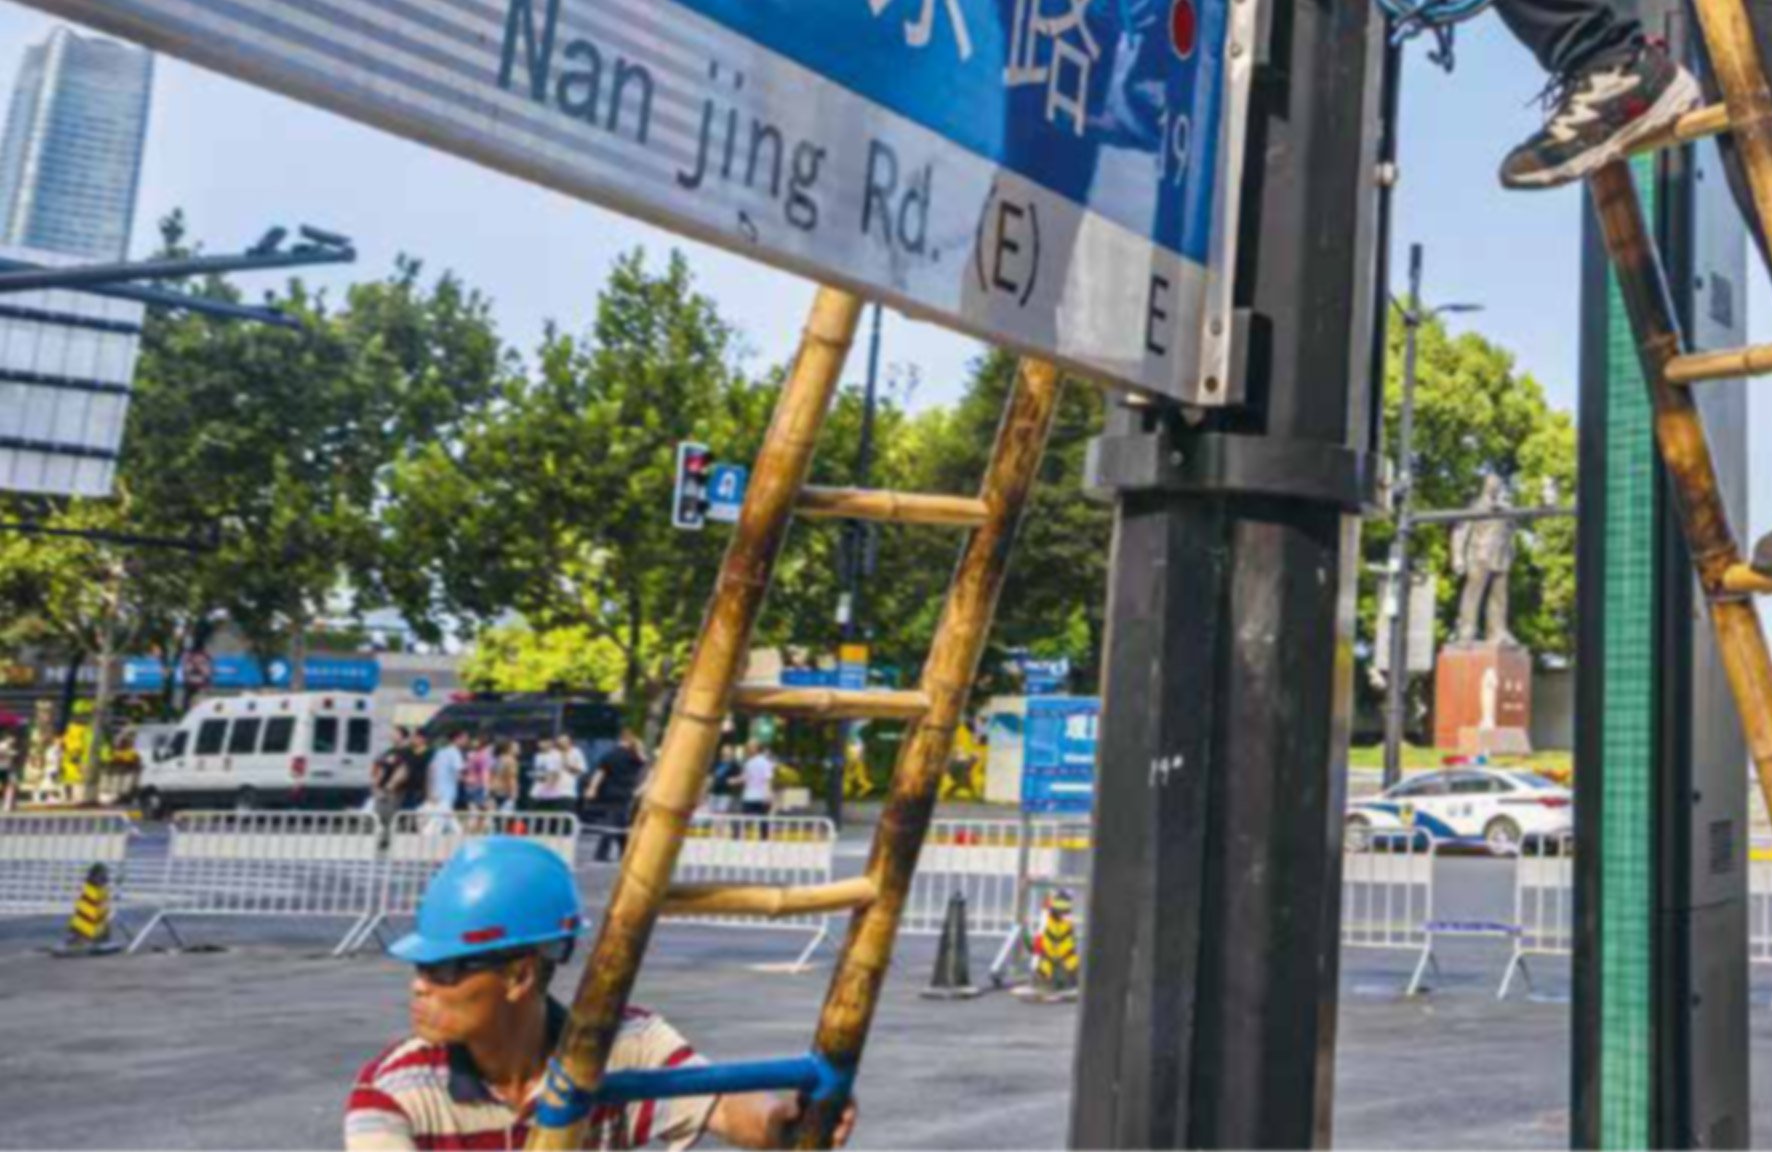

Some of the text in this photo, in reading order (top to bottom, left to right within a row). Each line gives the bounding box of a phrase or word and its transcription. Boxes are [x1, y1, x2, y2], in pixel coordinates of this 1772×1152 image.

[1157, 110, 1191, 187] 19
[860, 138, 941, 263] Rd.
[974, 180, 1041, 309] (E)
[1143, 273, 1171, 358] E
